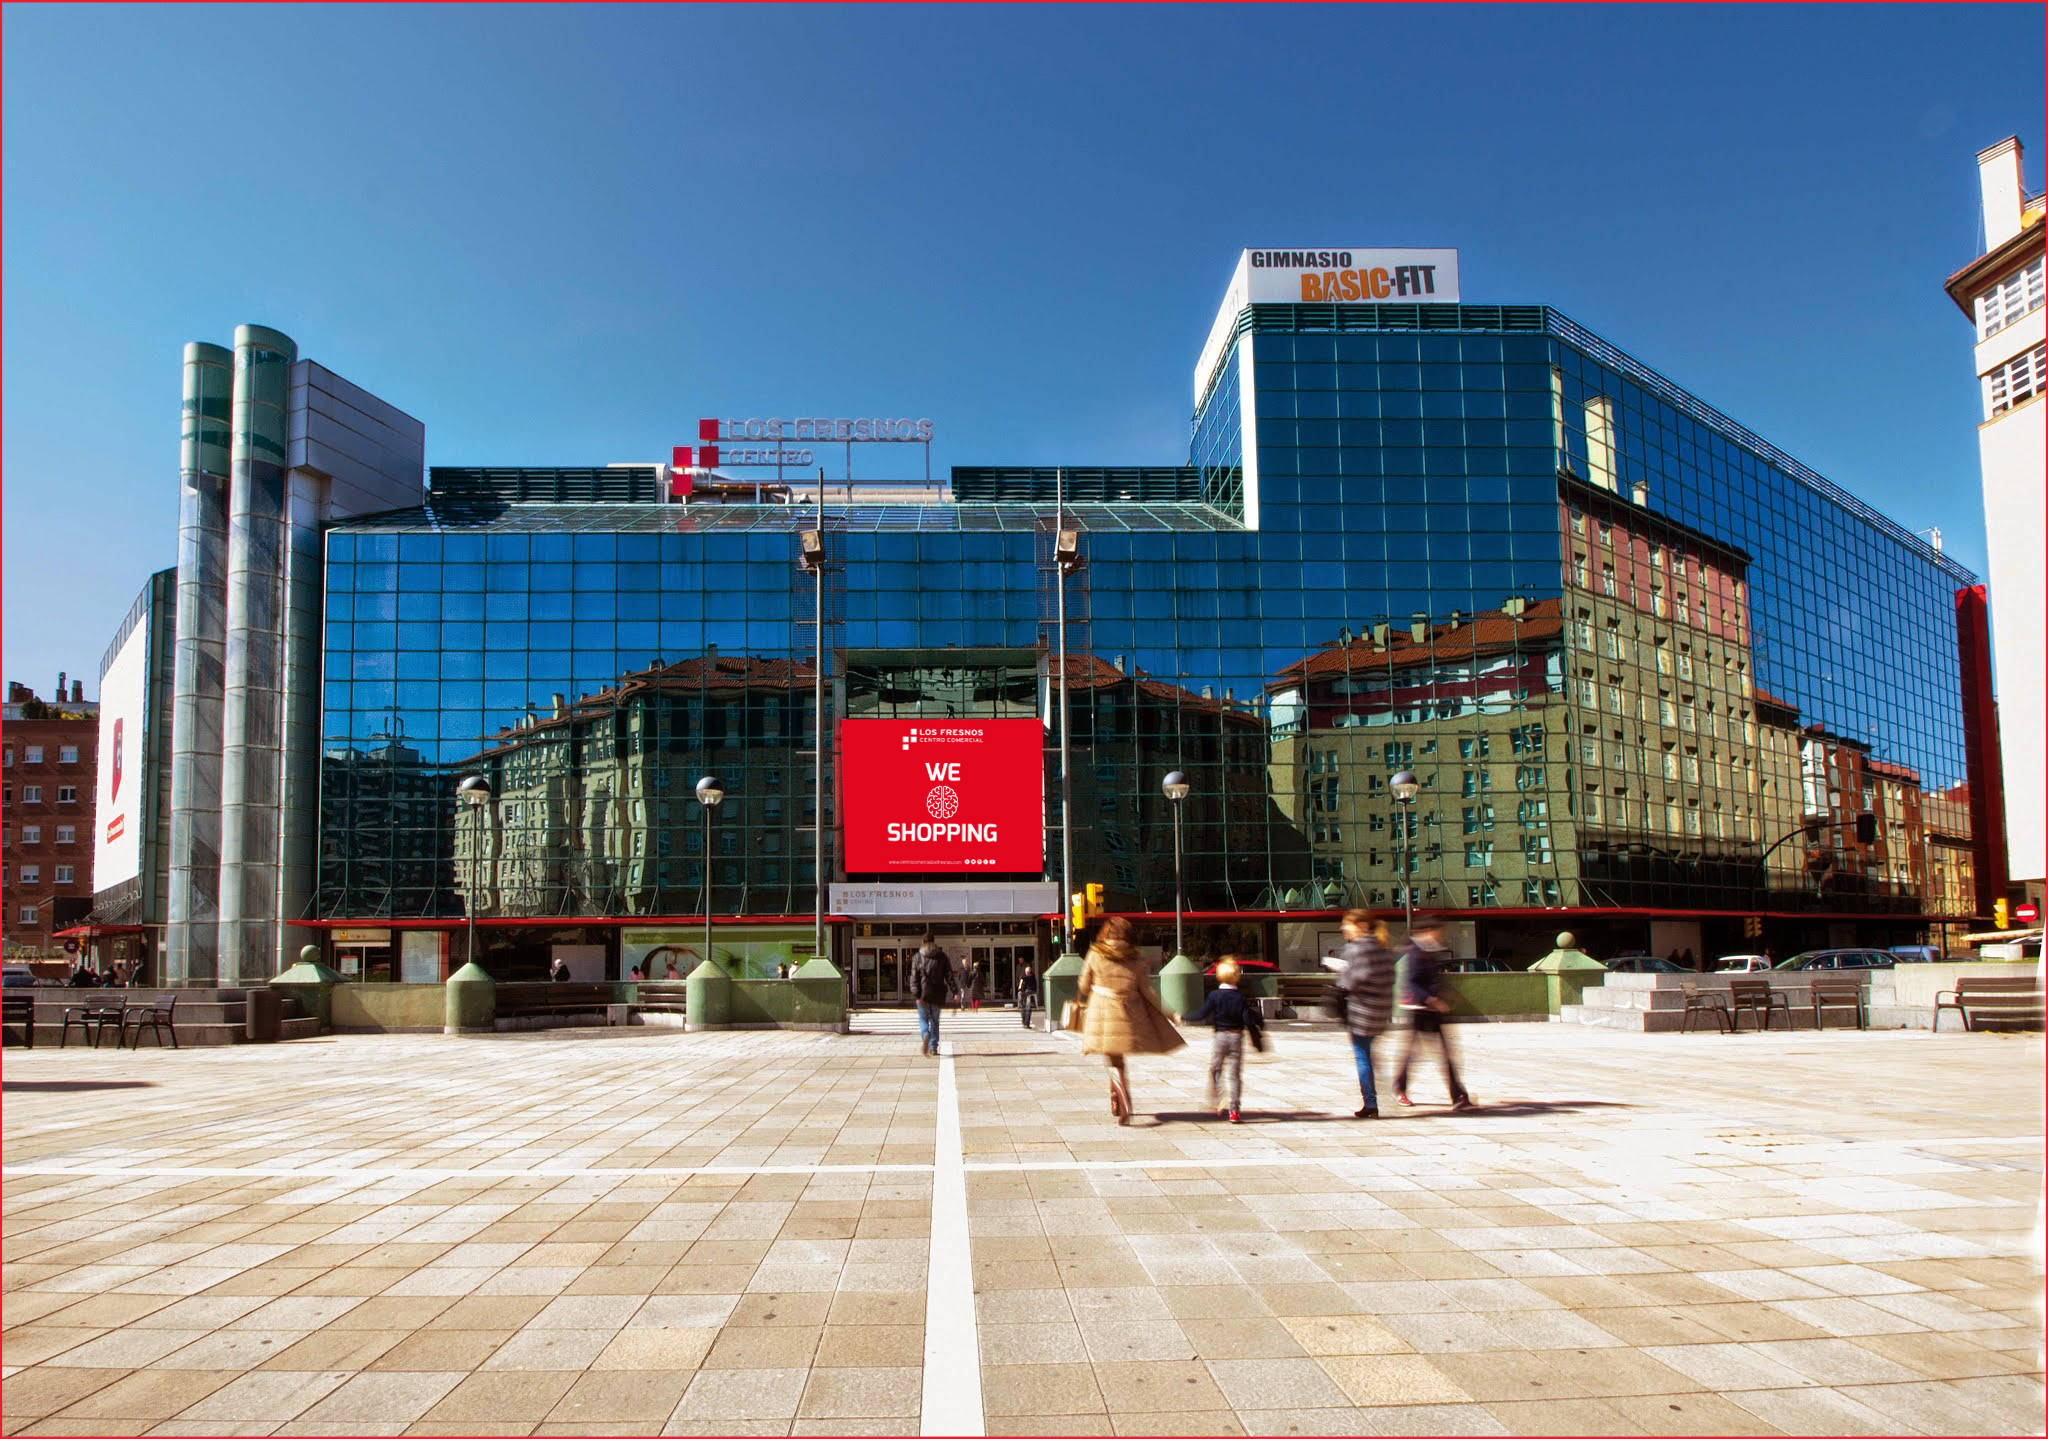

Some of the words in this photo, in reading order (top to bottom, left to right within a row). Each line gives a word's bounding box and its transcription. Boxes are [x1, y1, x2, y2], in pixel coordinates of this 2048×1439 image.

[1251, 251, 1352, 268] GIMNASIO
[728, 418, 784, 441] LOS
[794, 418, 934, 441] FRESNOS
[728, 448, 814, 467] CENTRO
[919, 728, 938, 736] LOS
[940, 728, 984, 736] FRESNOS
[925, 762, 961, 781] WE
[887, 823, 998, 842] SHOPPING
